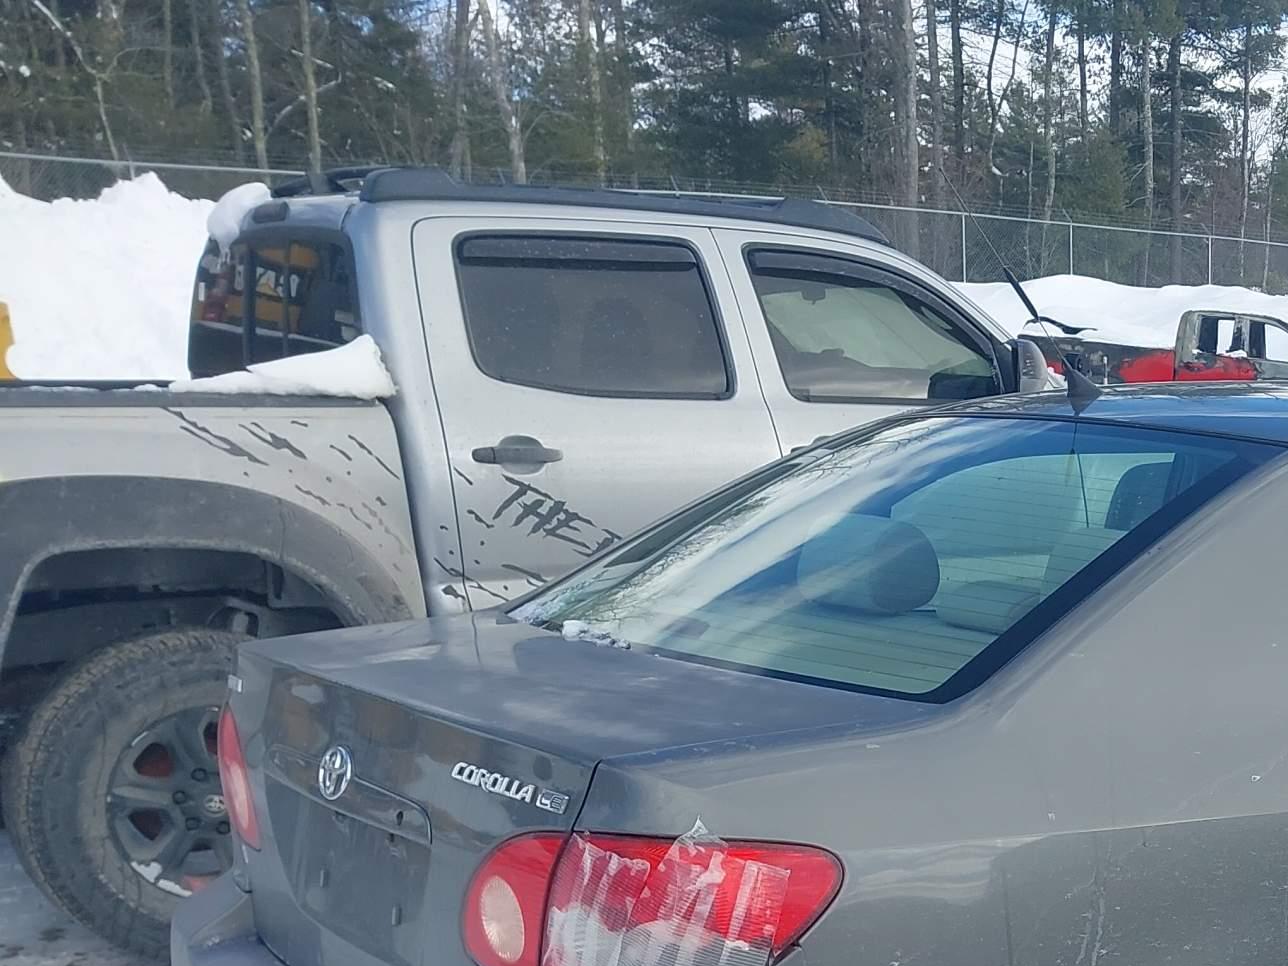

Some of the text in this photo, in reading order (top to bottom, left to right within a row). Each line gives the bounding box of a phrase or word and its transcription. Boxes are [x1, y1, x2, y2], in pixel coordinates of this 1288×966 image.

[492, 474, 597, 549] THE
[451, 761, 566, 812] COROLLA LE
